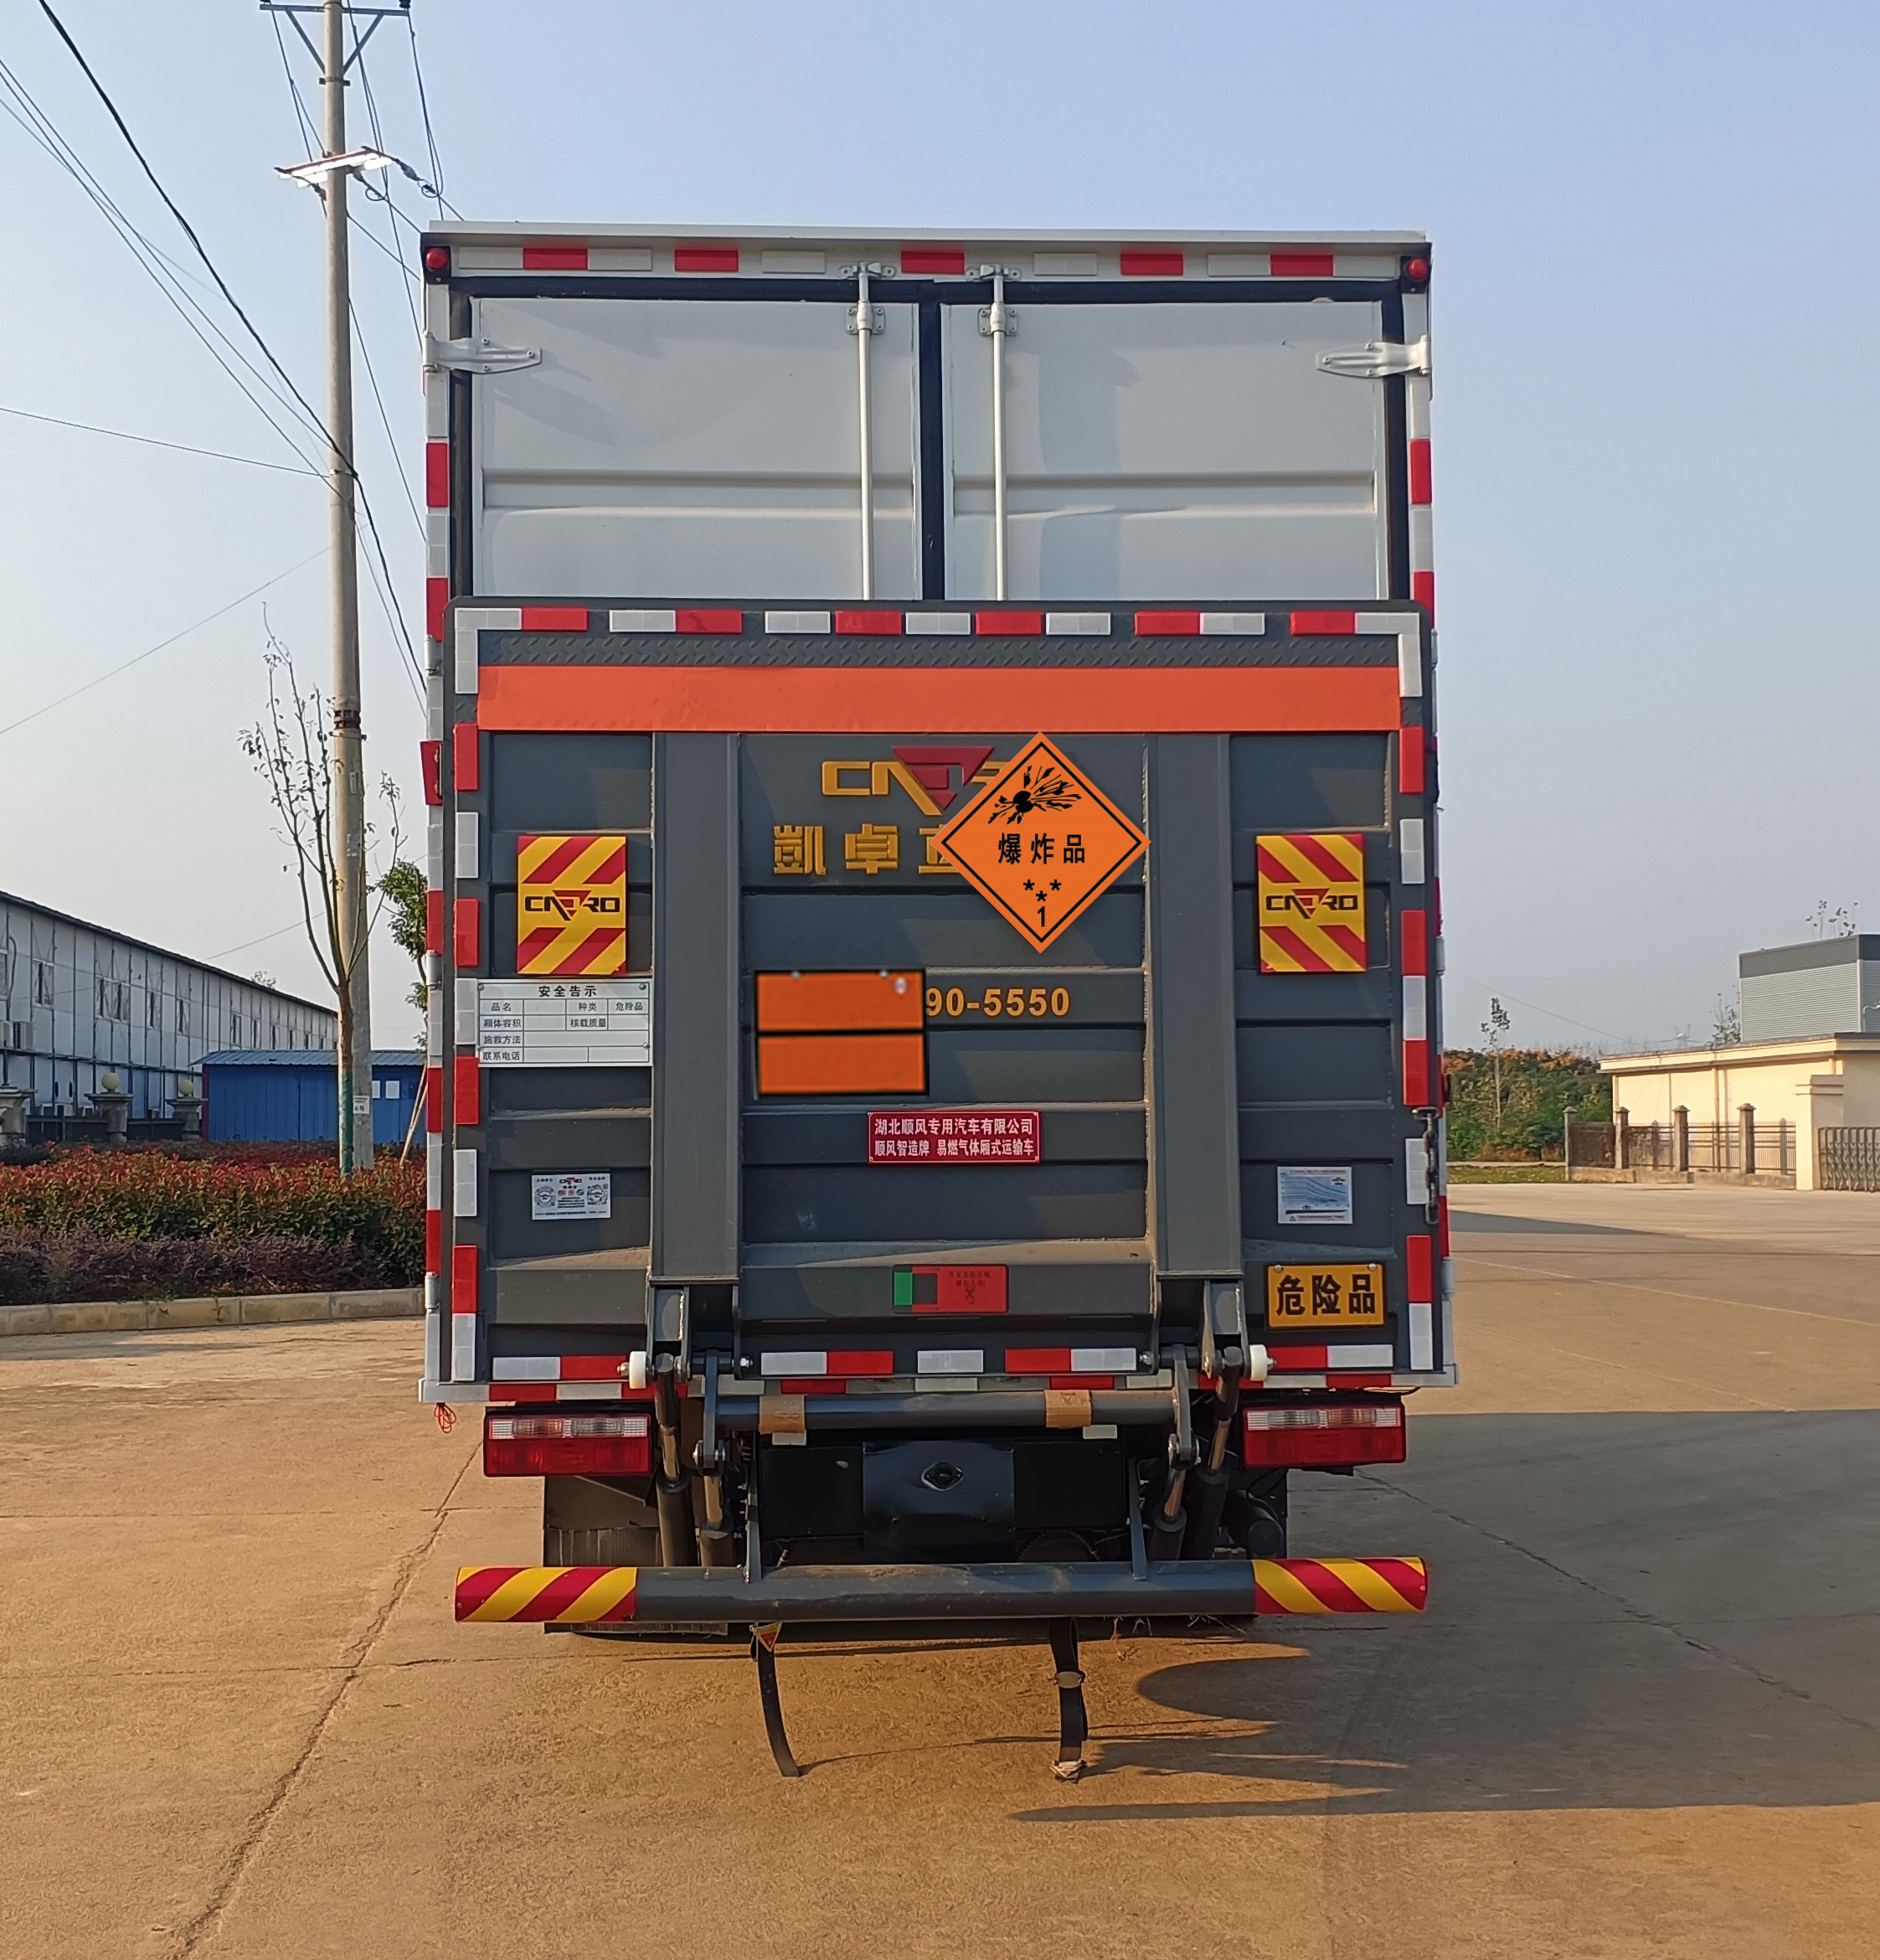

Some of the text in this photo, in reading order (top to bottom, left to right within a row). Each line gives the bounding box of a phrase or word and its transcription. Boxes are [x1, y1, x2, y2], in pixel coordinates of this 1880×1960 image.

[997, 833, 1086, 865] 爆炸品
[1037, 905, 1046, 927] 1
[538, 985, 597, 998] 安全告示
[491, 1002, 512, 1012] 品名
[578, 1002, 597, 1012] 种类
[615, 1002, 643, 1012] 危险品
[482, 1050, 520, 1061] 联系电话
[874, 1118, 1033, 1136] 湖北顺风专用汽车有限公司
[874, 1138, 1034, 1157] 顺风智造牌 易燃气体厢式运输车
[1275, 1273, 1376, 1316] 危险品
